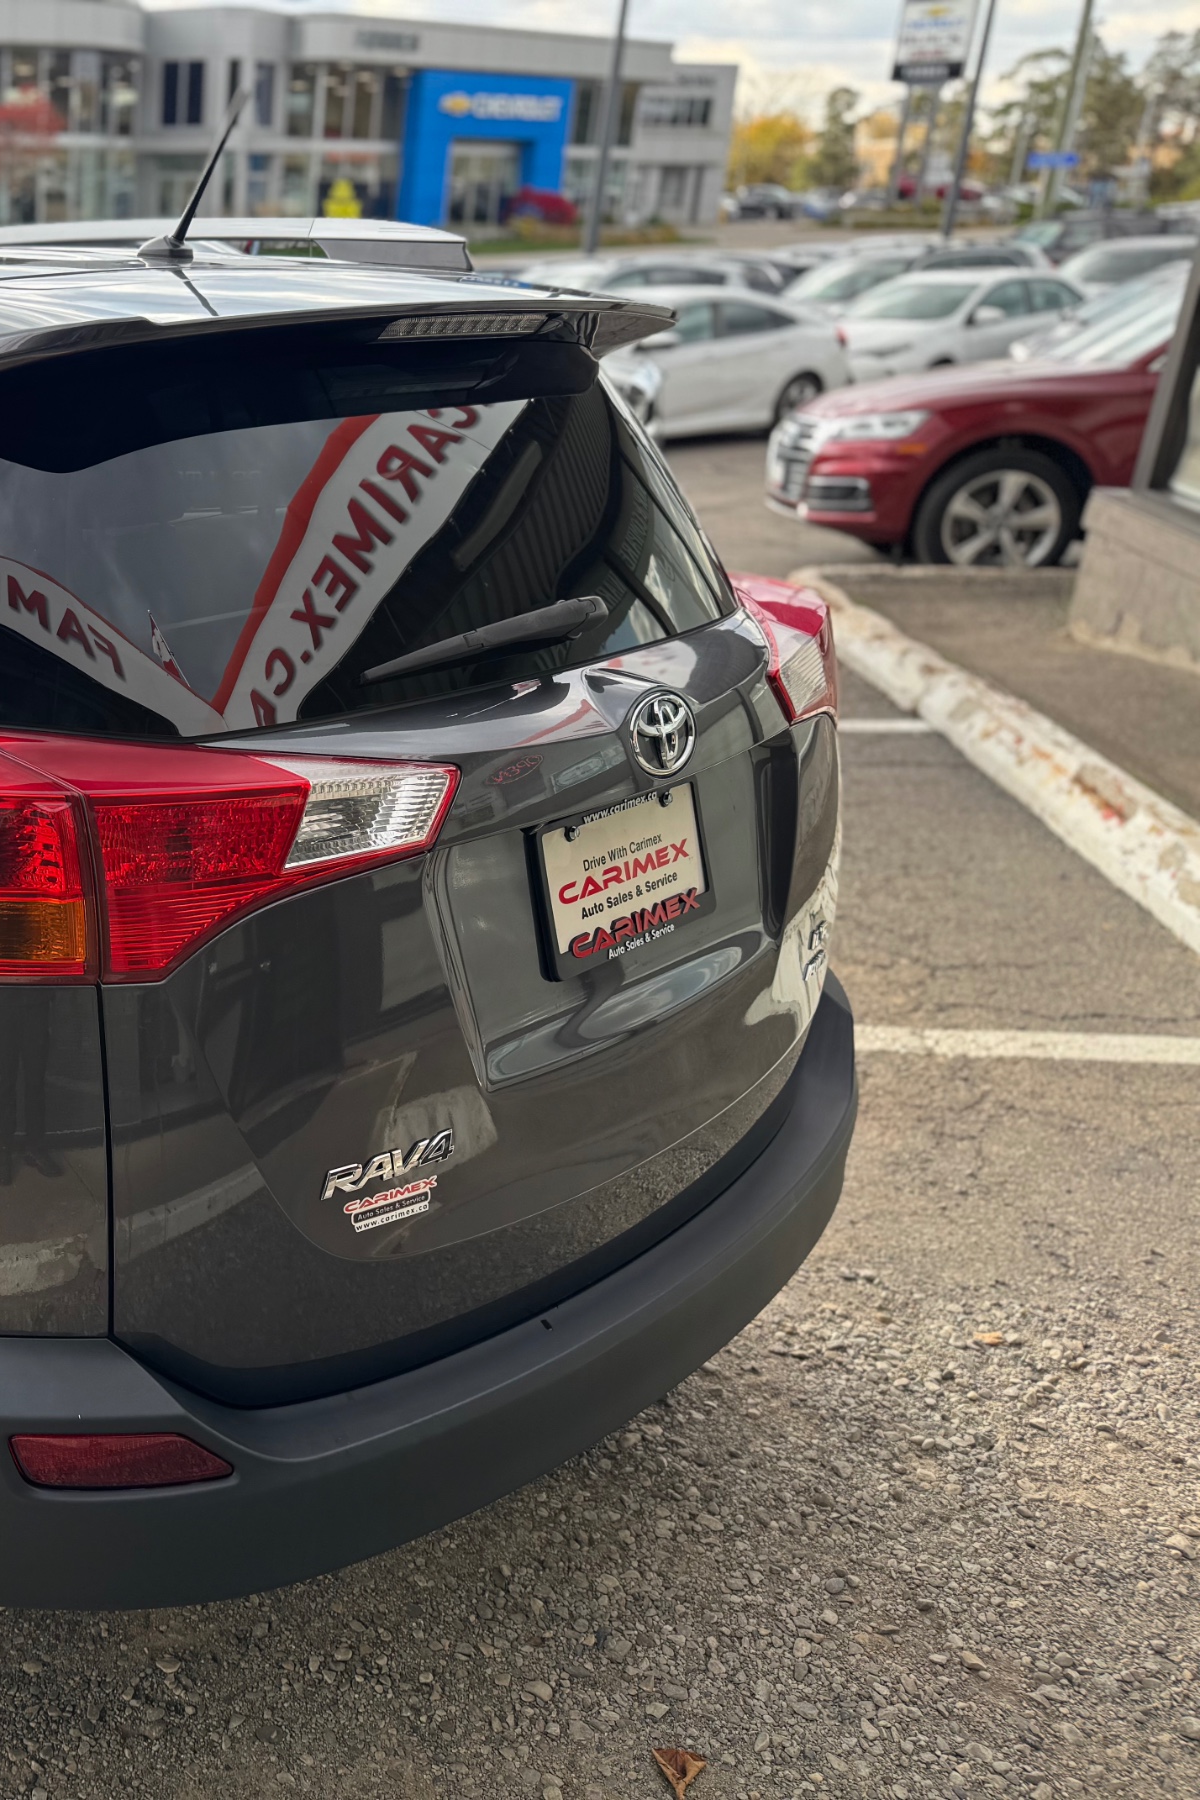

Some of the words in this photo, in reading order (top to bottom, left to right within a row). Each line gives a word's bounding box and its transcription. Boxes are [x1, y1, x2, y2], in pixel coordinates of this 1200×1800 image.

[583, 790, 658, 824] www.carimex.ca
[558, 838, 690, 905] CARIMEX
[583, 854, 607, 872] Drive
[607, 843, 628, 863] With
[629, 834, 662, 855] Carimex
[581, 901, 604, 920] Auto
[606, 890, 633, 911] Sales
[636, 884, 644, 897] &
[645, 871, 678, 894] Service
[570, 887, 700, 959] CARIMEX
[608, 940, 625, 960] Auto
[626, 933, 644, 951] Sales
[645, 929, 651, 942] &
[651, 922, 675, 942] Service
[321, 1128, 455, 1200] RAV4
[344, 1175, 438, 1213] CARIMEX
[357, 1210, 374, 1221] Auto
[375, 1204, 394, 1216] Sales
[402, 1194, 426, 1208] Service
[355, 1203, 429, 1232] www.carimex.ca
